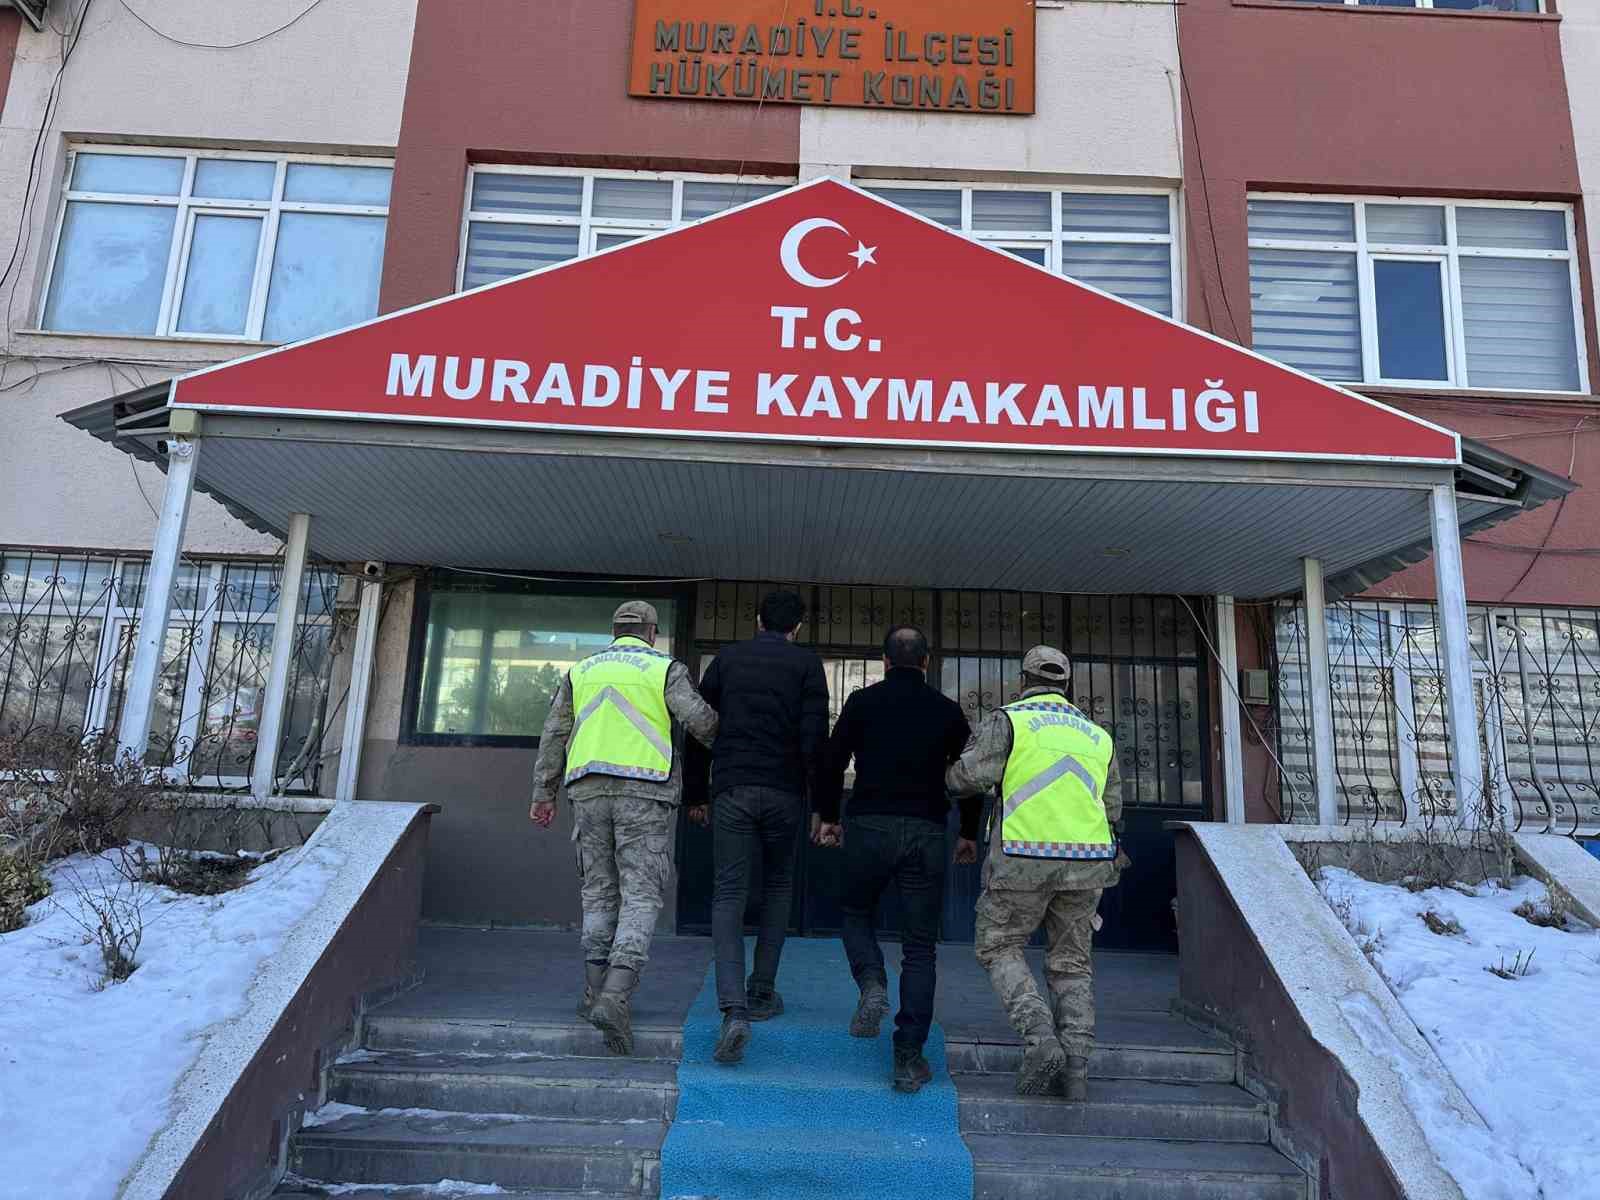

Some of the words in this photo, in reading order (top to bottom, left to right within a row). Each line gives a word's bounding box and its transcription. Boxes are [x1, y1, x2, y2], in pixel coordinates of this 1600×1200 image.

[655, 17, 862, 59] MURADİYE
[884, 22, 1015, 67] İLÇESİ
[649, 56, 840, 102] HÜKÜMET
[863, 69, 1015, 110] KONAĞI
[770, 305, 881, 352] T.C.
[385, 353, 731, 414] MURADİYE
[755, 373, 1260, 433] KAYMAKAMLIĞI
[1028, 713, 1100, 746] JANDARMA
